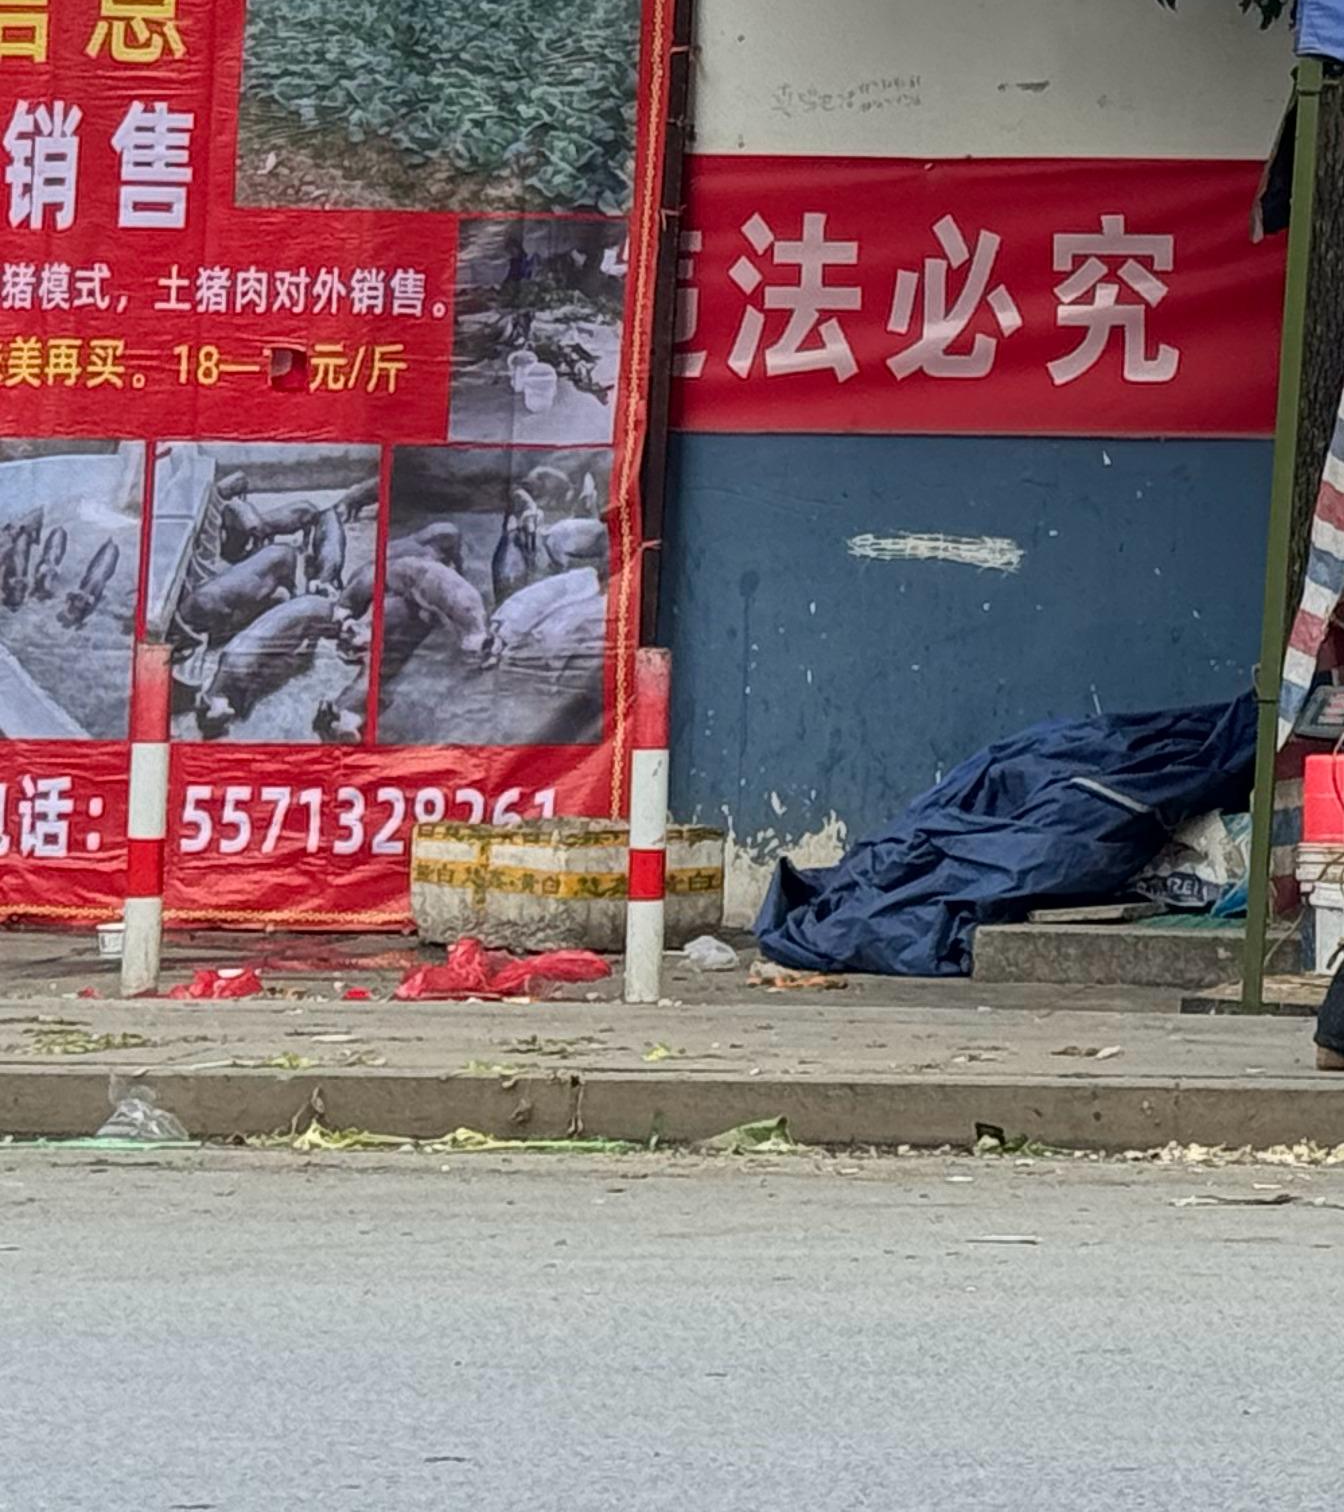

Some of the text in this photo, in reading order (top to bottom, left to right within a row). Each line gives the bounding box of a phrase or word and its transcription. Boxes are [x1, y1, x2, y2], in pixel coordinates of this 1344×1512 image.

[2, 99, 195, 231] 销售
[672, 212, 1180, 386] 法必究
[0, 774, 104, 857] 话：
